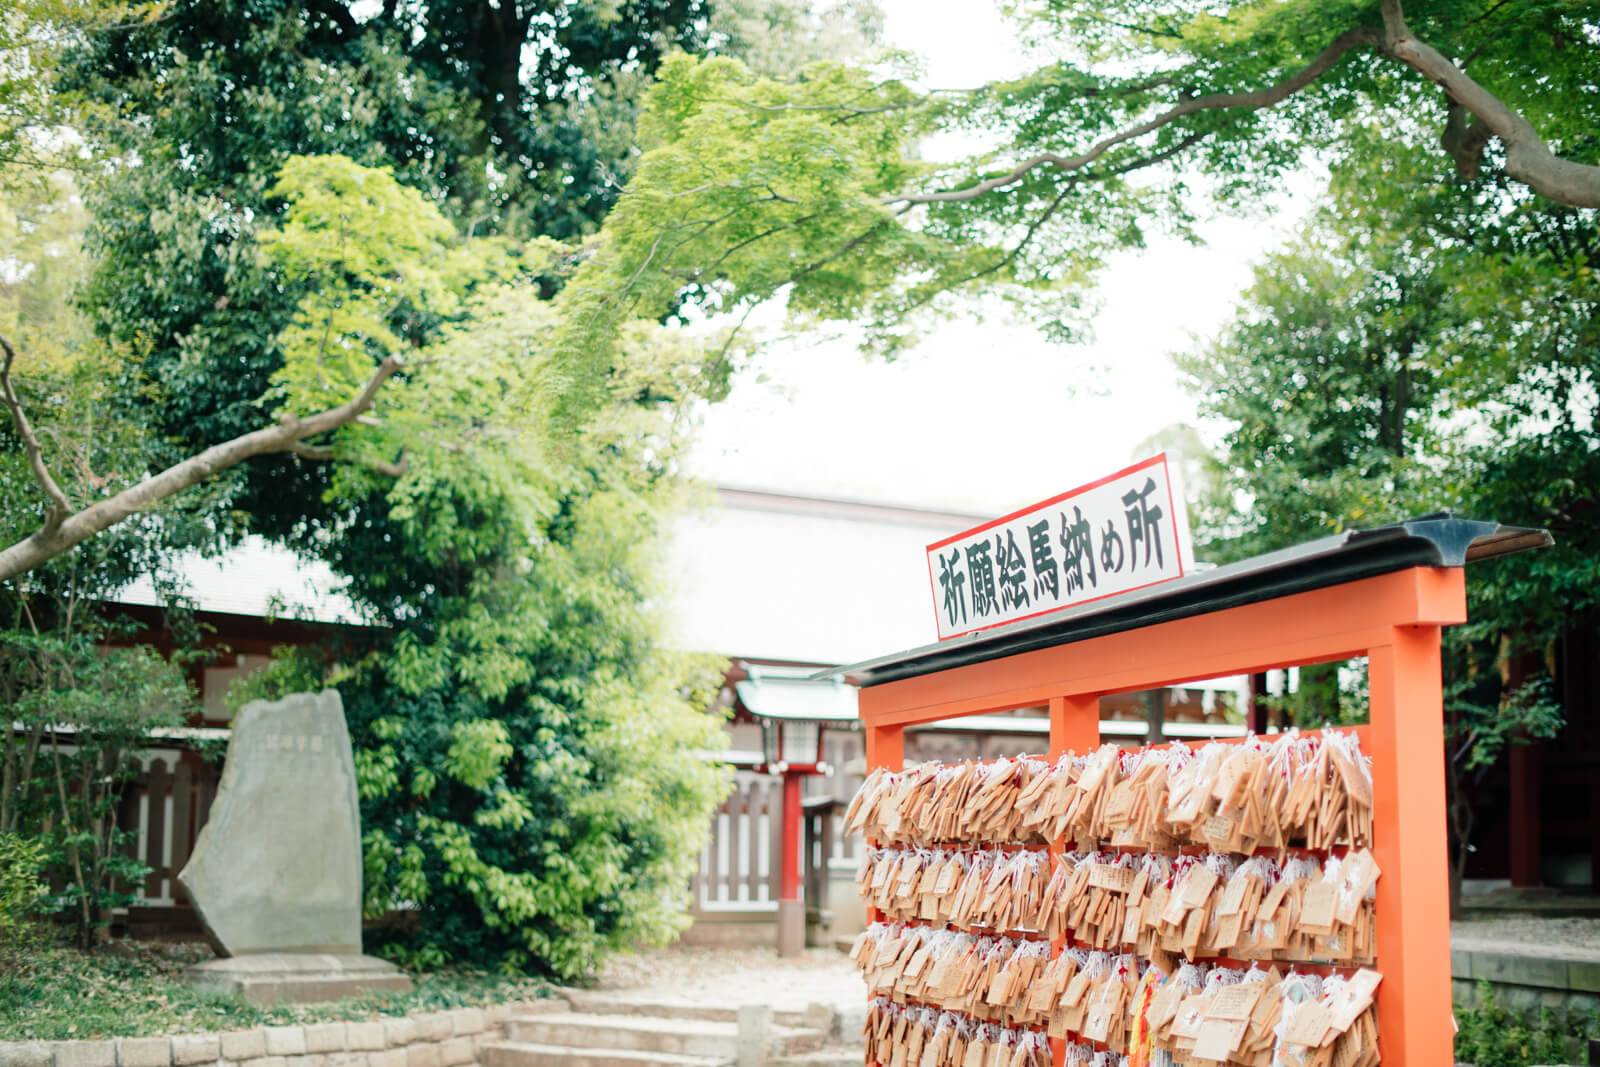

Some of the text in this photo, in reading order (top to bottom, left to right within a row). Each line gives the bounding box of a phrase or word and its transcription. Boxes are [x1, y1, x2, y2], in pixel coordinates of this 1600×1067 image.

[939, 477, 1163, 627] 祈願絵馬納め所
